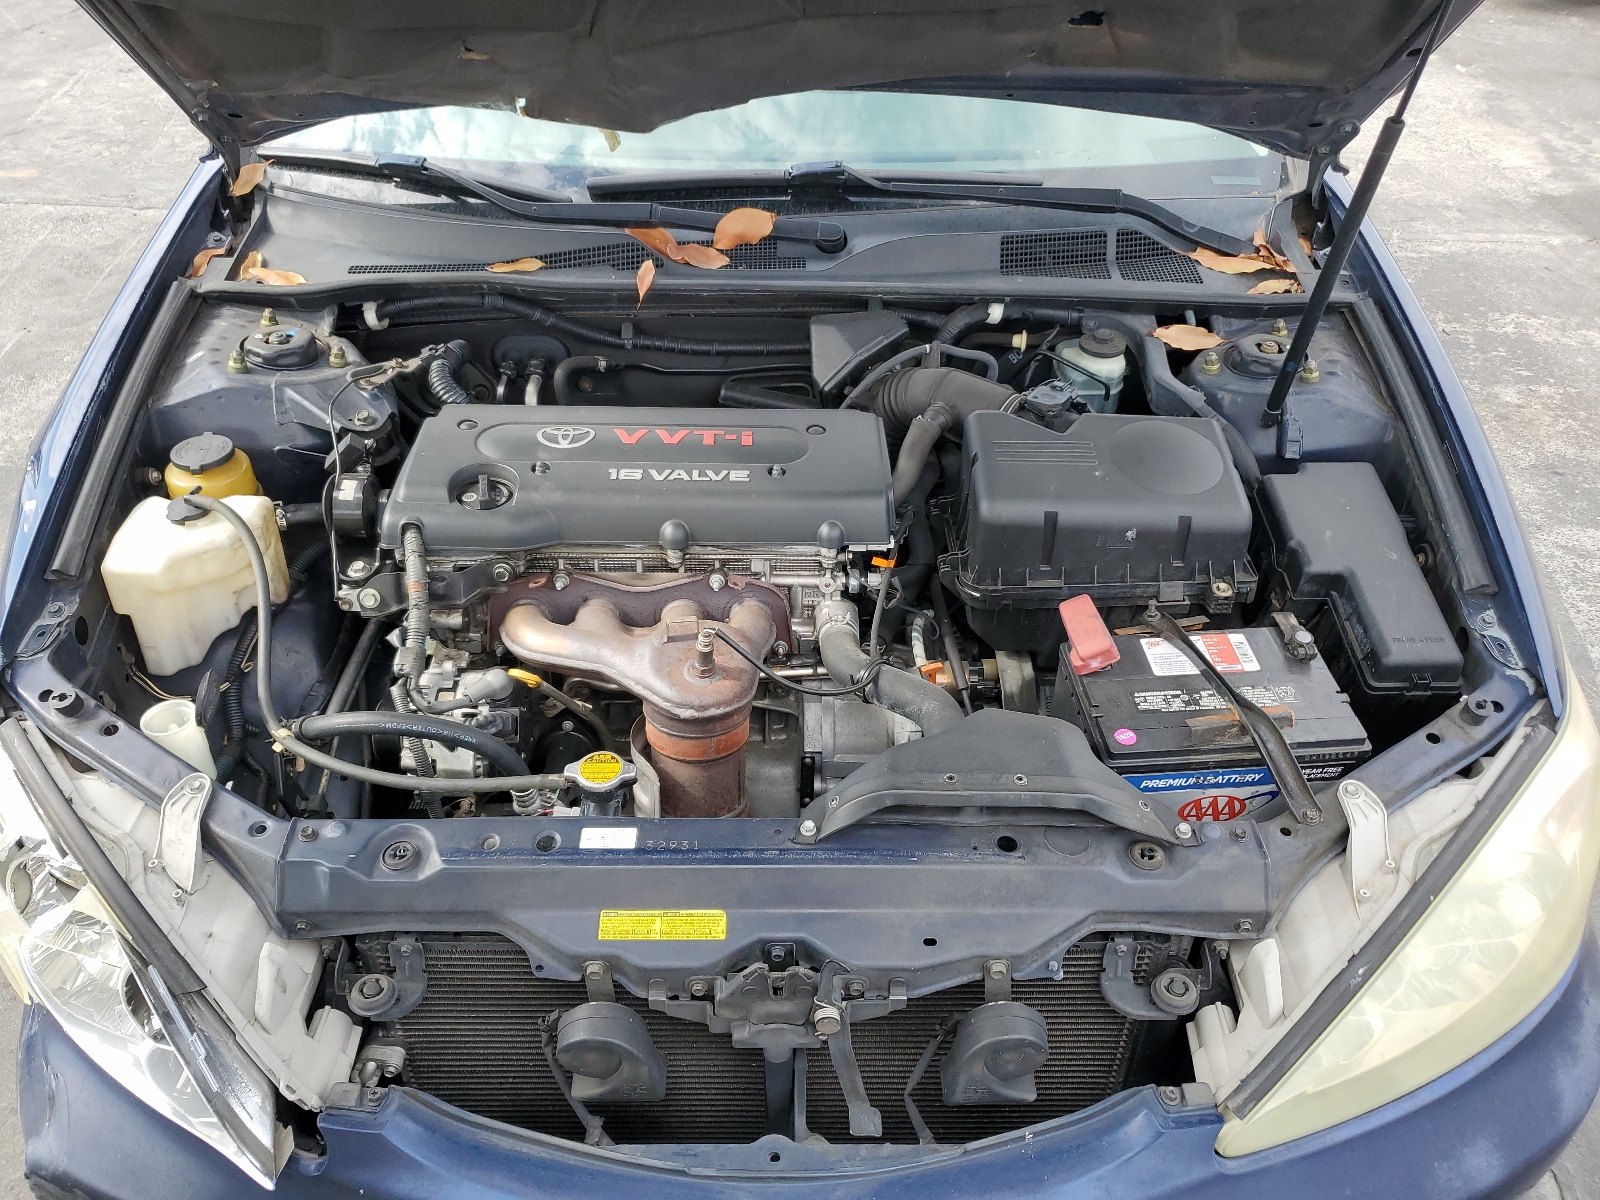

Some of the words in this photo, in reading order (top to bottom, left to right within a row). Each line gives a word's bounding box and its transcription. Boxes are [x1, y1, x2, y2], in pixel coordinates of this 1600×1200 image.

[613, 428, 753, 446] VVT-i
[608, 468, 644, 481] 16
[648, 469, 751, 482] VALVE
[1140, 775, 1203, 789] PREMIUM
[1204, 773, 1265, 785] BATTERY
[1178, 795, 1246, 821] AAA
[645, 840, 699, 850] 32931
